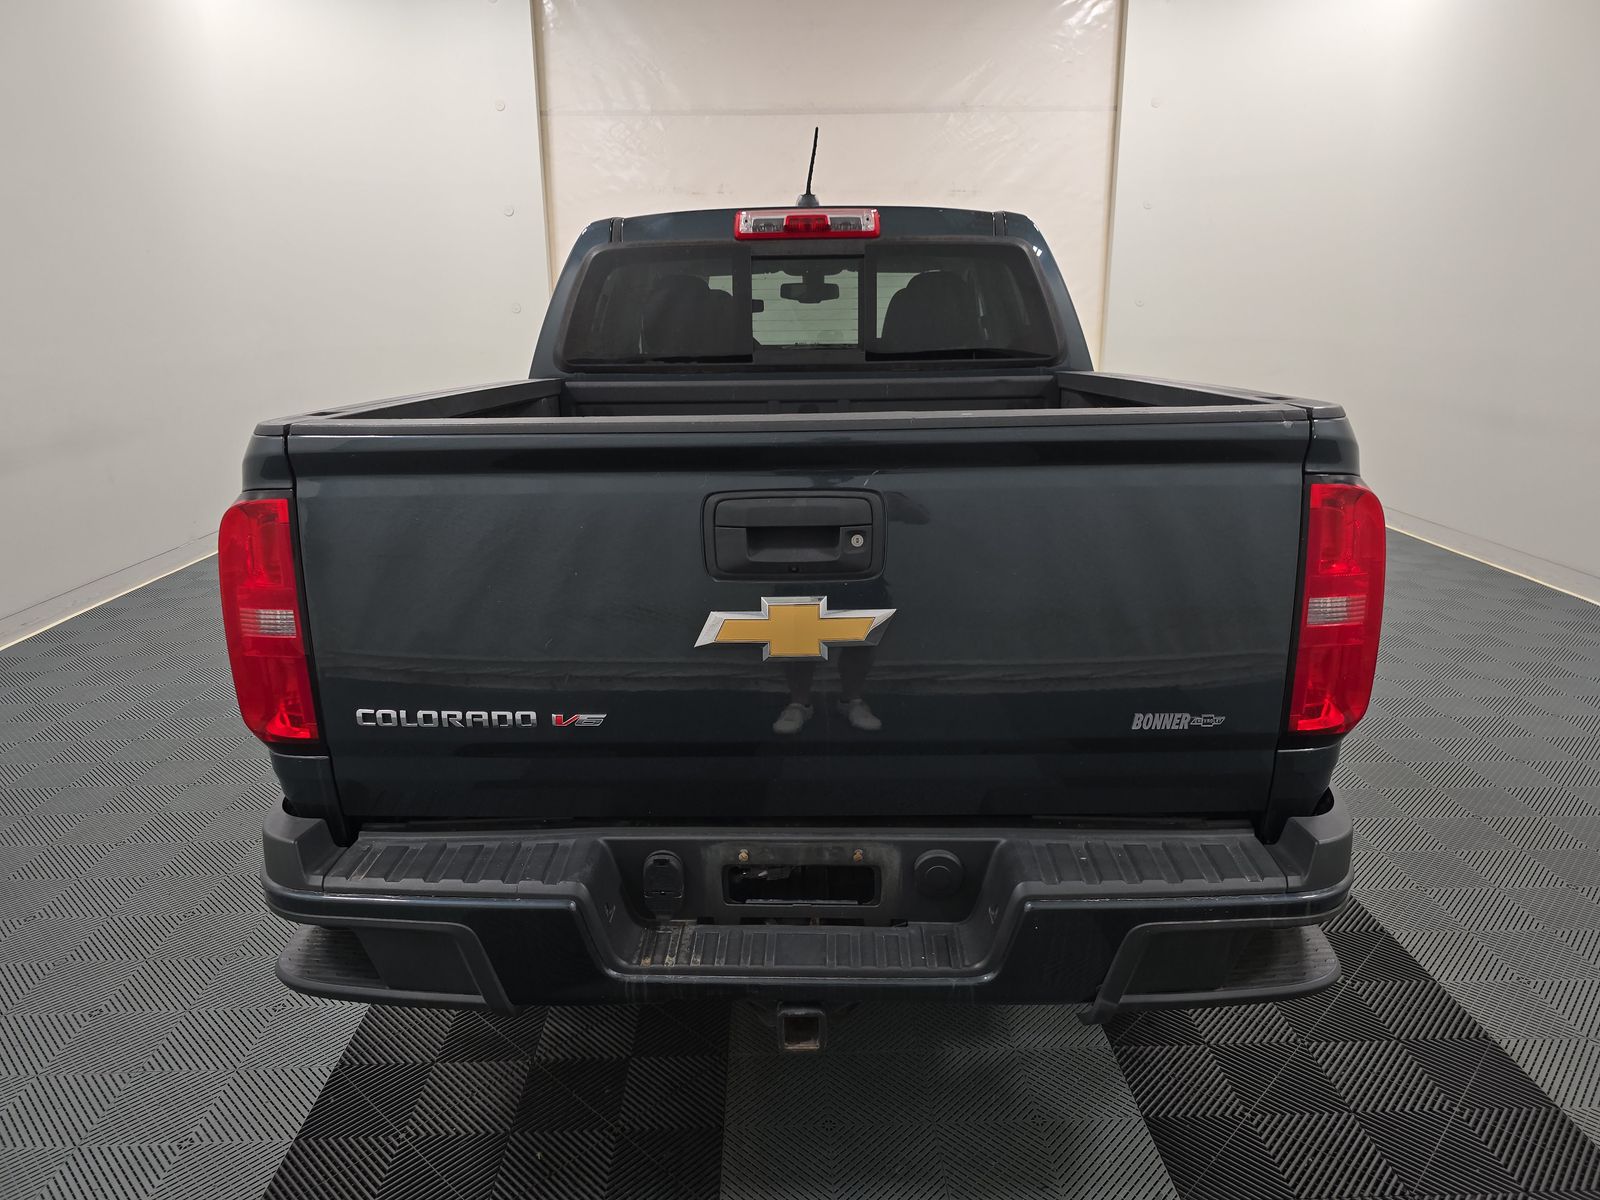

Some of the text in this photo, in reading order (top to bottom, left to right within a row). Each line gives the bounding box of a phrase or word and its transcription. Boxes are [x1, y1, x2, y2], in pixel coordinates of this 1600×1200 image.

[356, 708, 607, 728] COLORADO V6
[1131, 712, 1191, 730] BONNER
